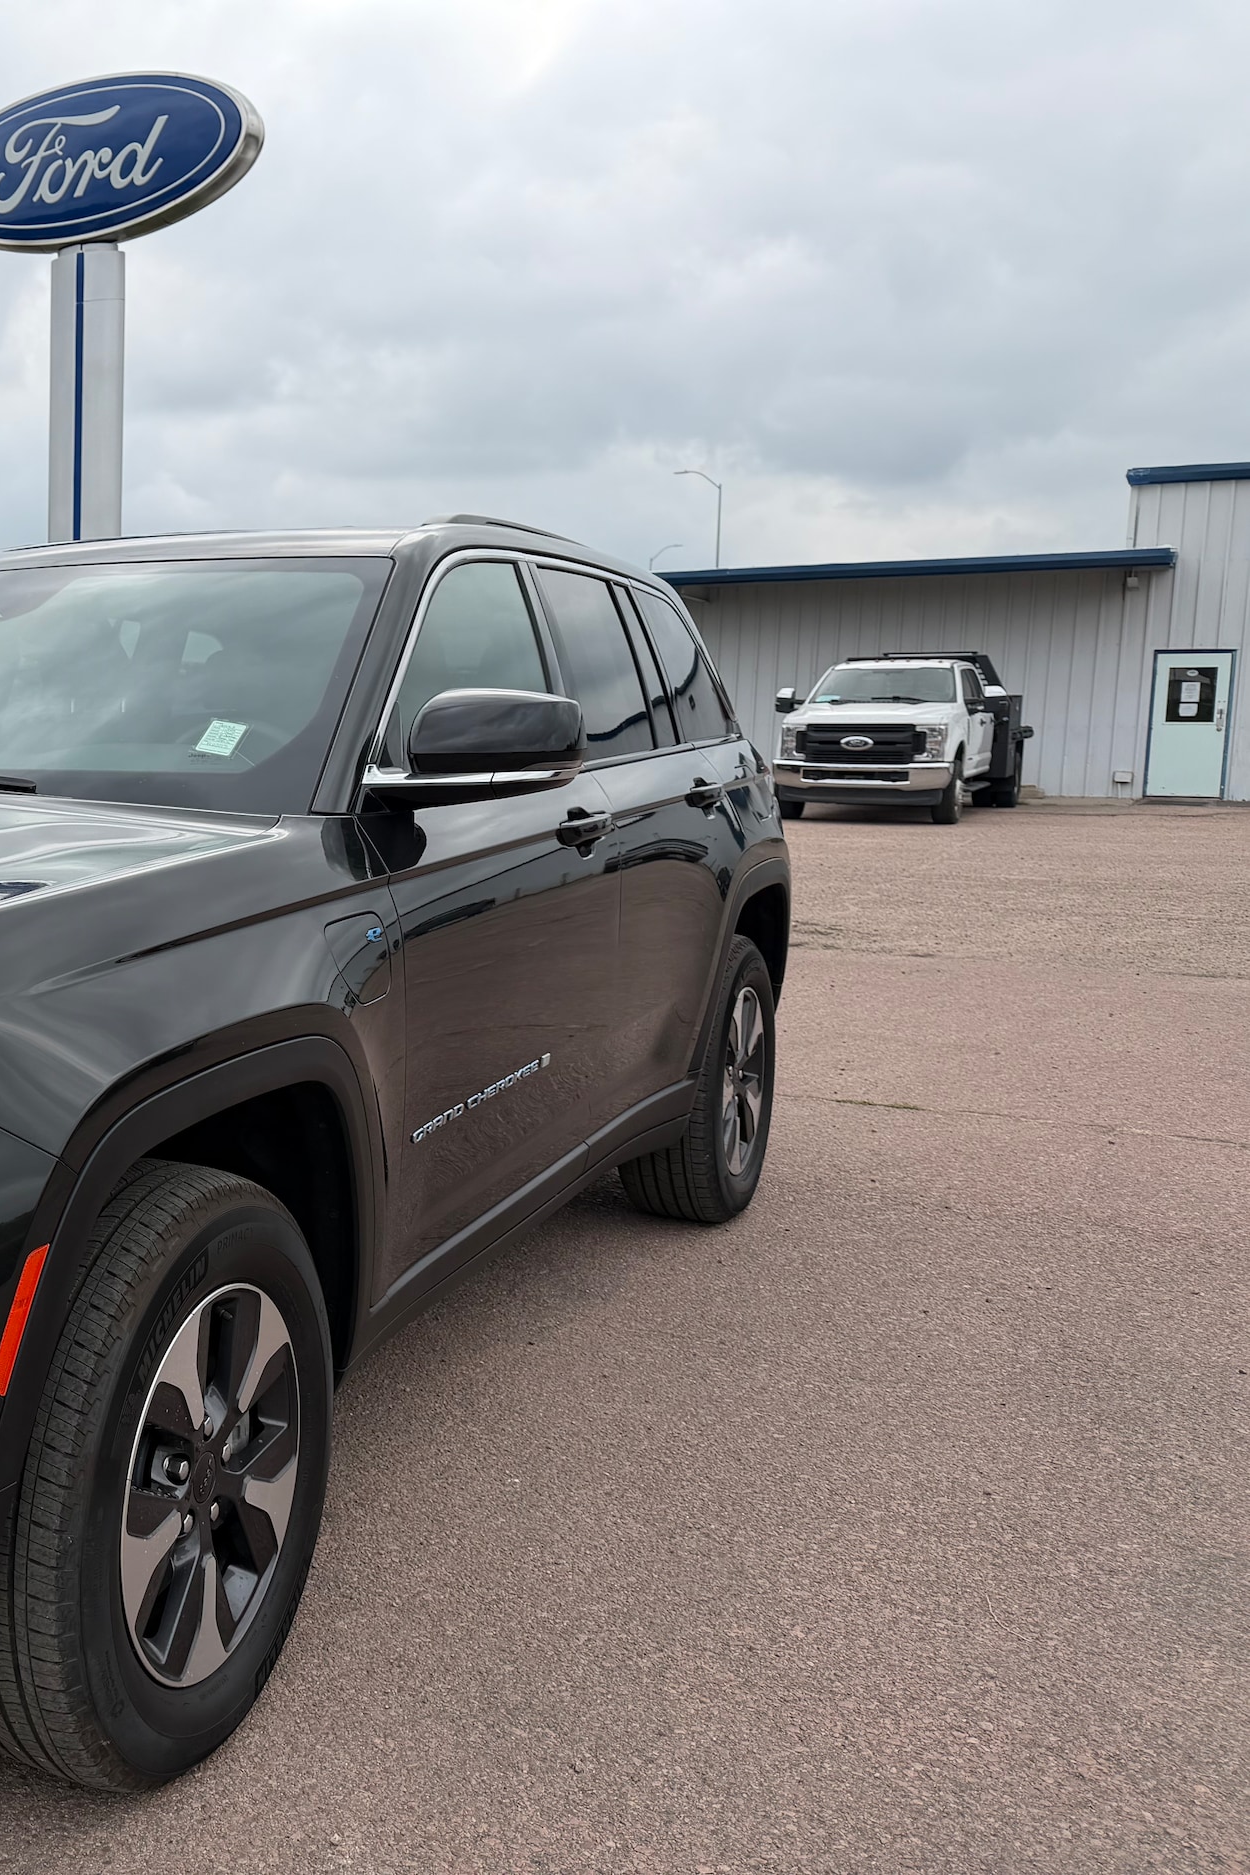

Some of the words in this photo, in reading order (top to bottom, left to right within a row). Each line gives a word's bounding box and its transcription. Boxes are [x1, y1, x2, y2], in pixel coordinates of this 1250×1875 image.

[410, 1103, 464, 1144] GRAND
[465, 1059, 540, 1110] CHEROKEE
[138, 1254, 207, 1385] MICHELIN
